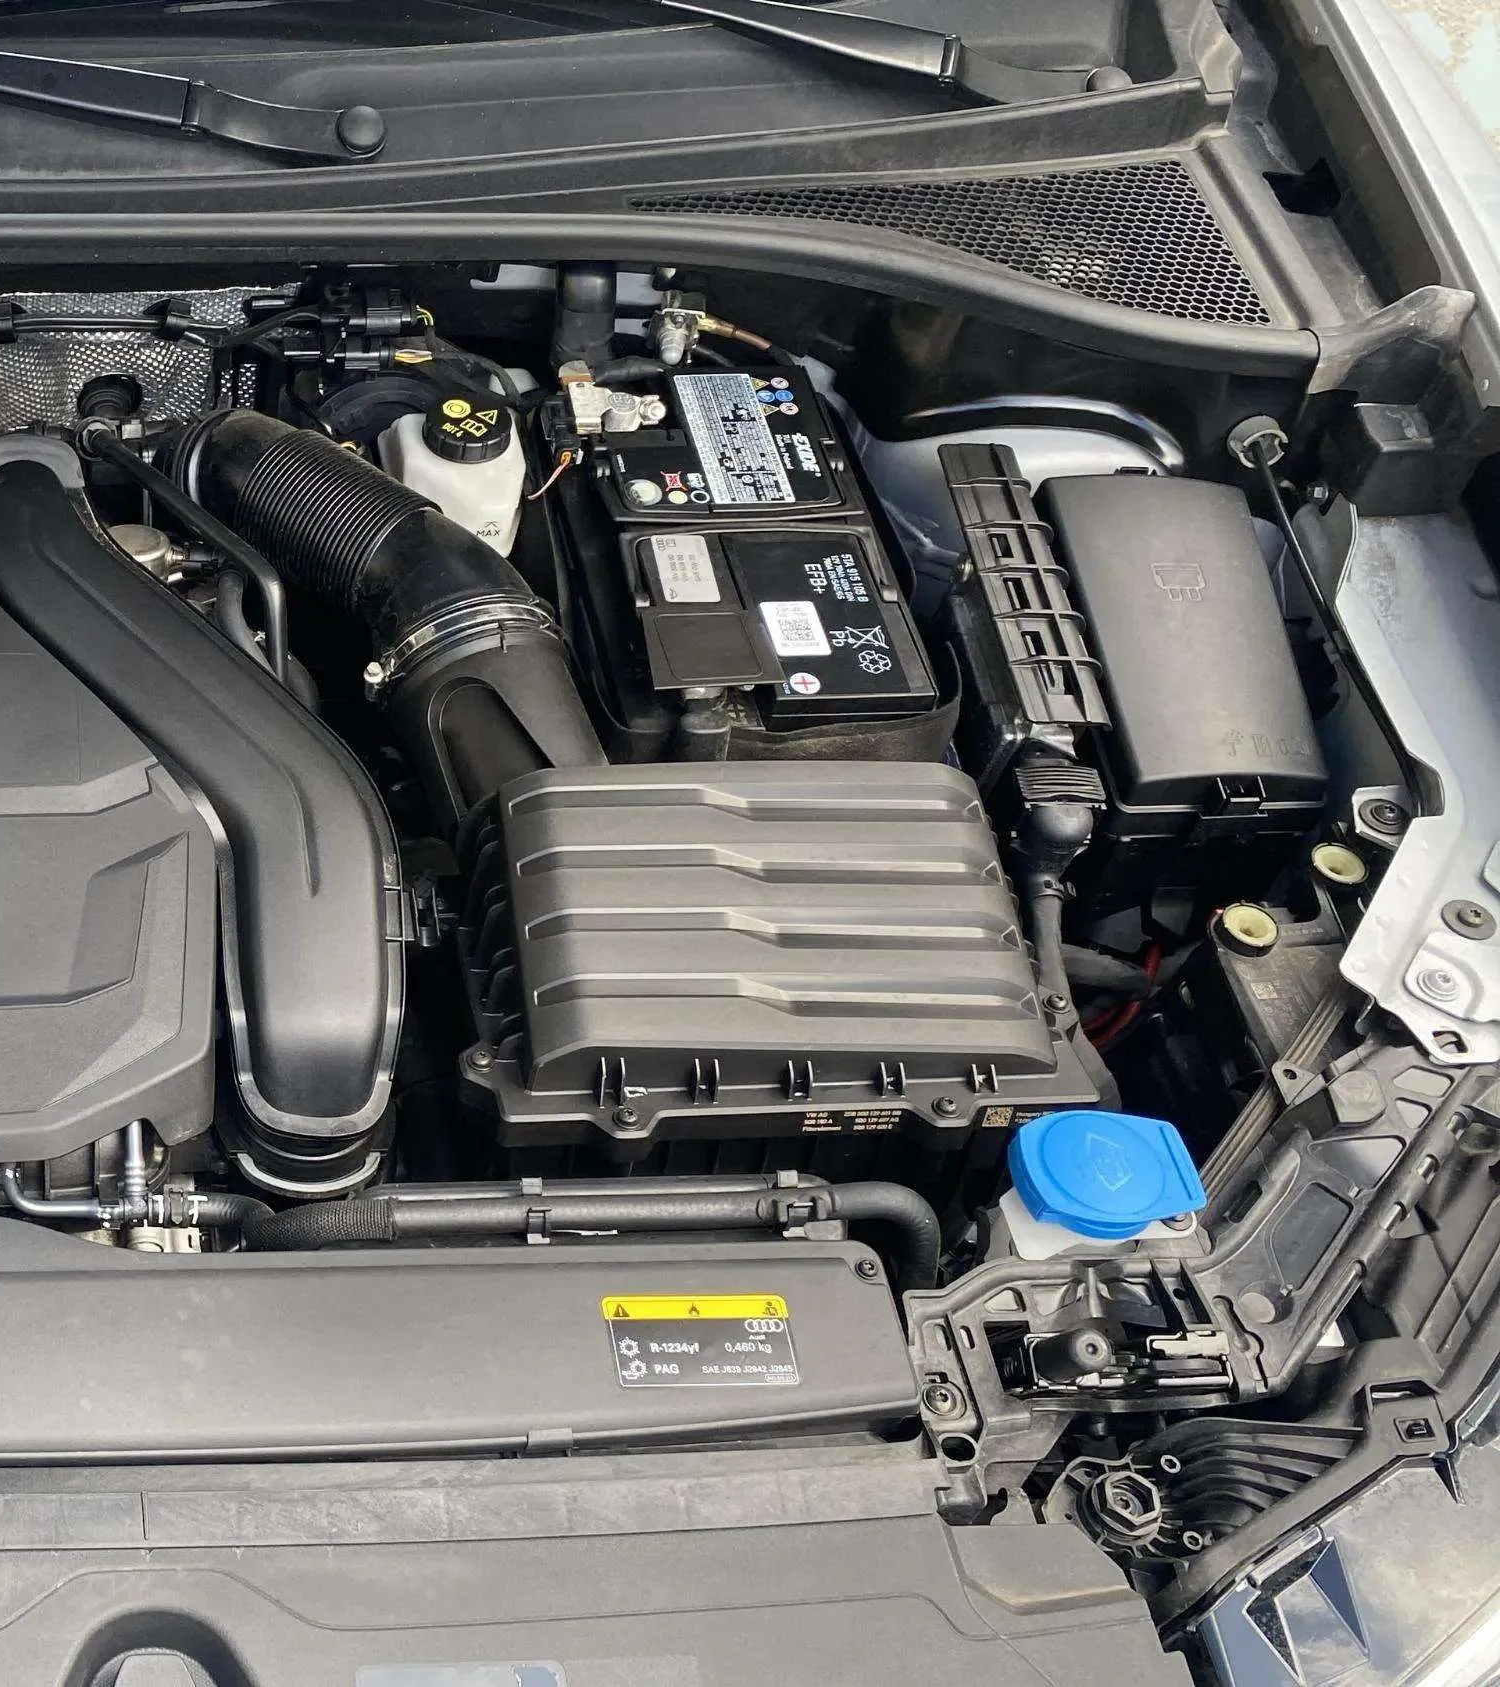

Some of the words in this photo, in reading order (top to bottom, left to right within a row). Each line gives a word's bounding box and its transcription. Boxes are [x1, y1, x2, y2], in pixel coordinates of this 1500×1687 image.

[442, 423, 457, 436] DOT
[791, 432, 820, 473] EXIDE
[476, 529, 500, 537] MAX
[804, 563, 828, 594] EFB+
[847, 568, 861, 581] 915
[852, 583, 866, 595] 105
[829, 630, 848, 647] Pb
[757, 1342, 773, 1354] kg
[654, 1363, 680, 1375] PAG
[701, 1365, 720, 1374] SAE
[721, 1365, 742, 1374] J639
